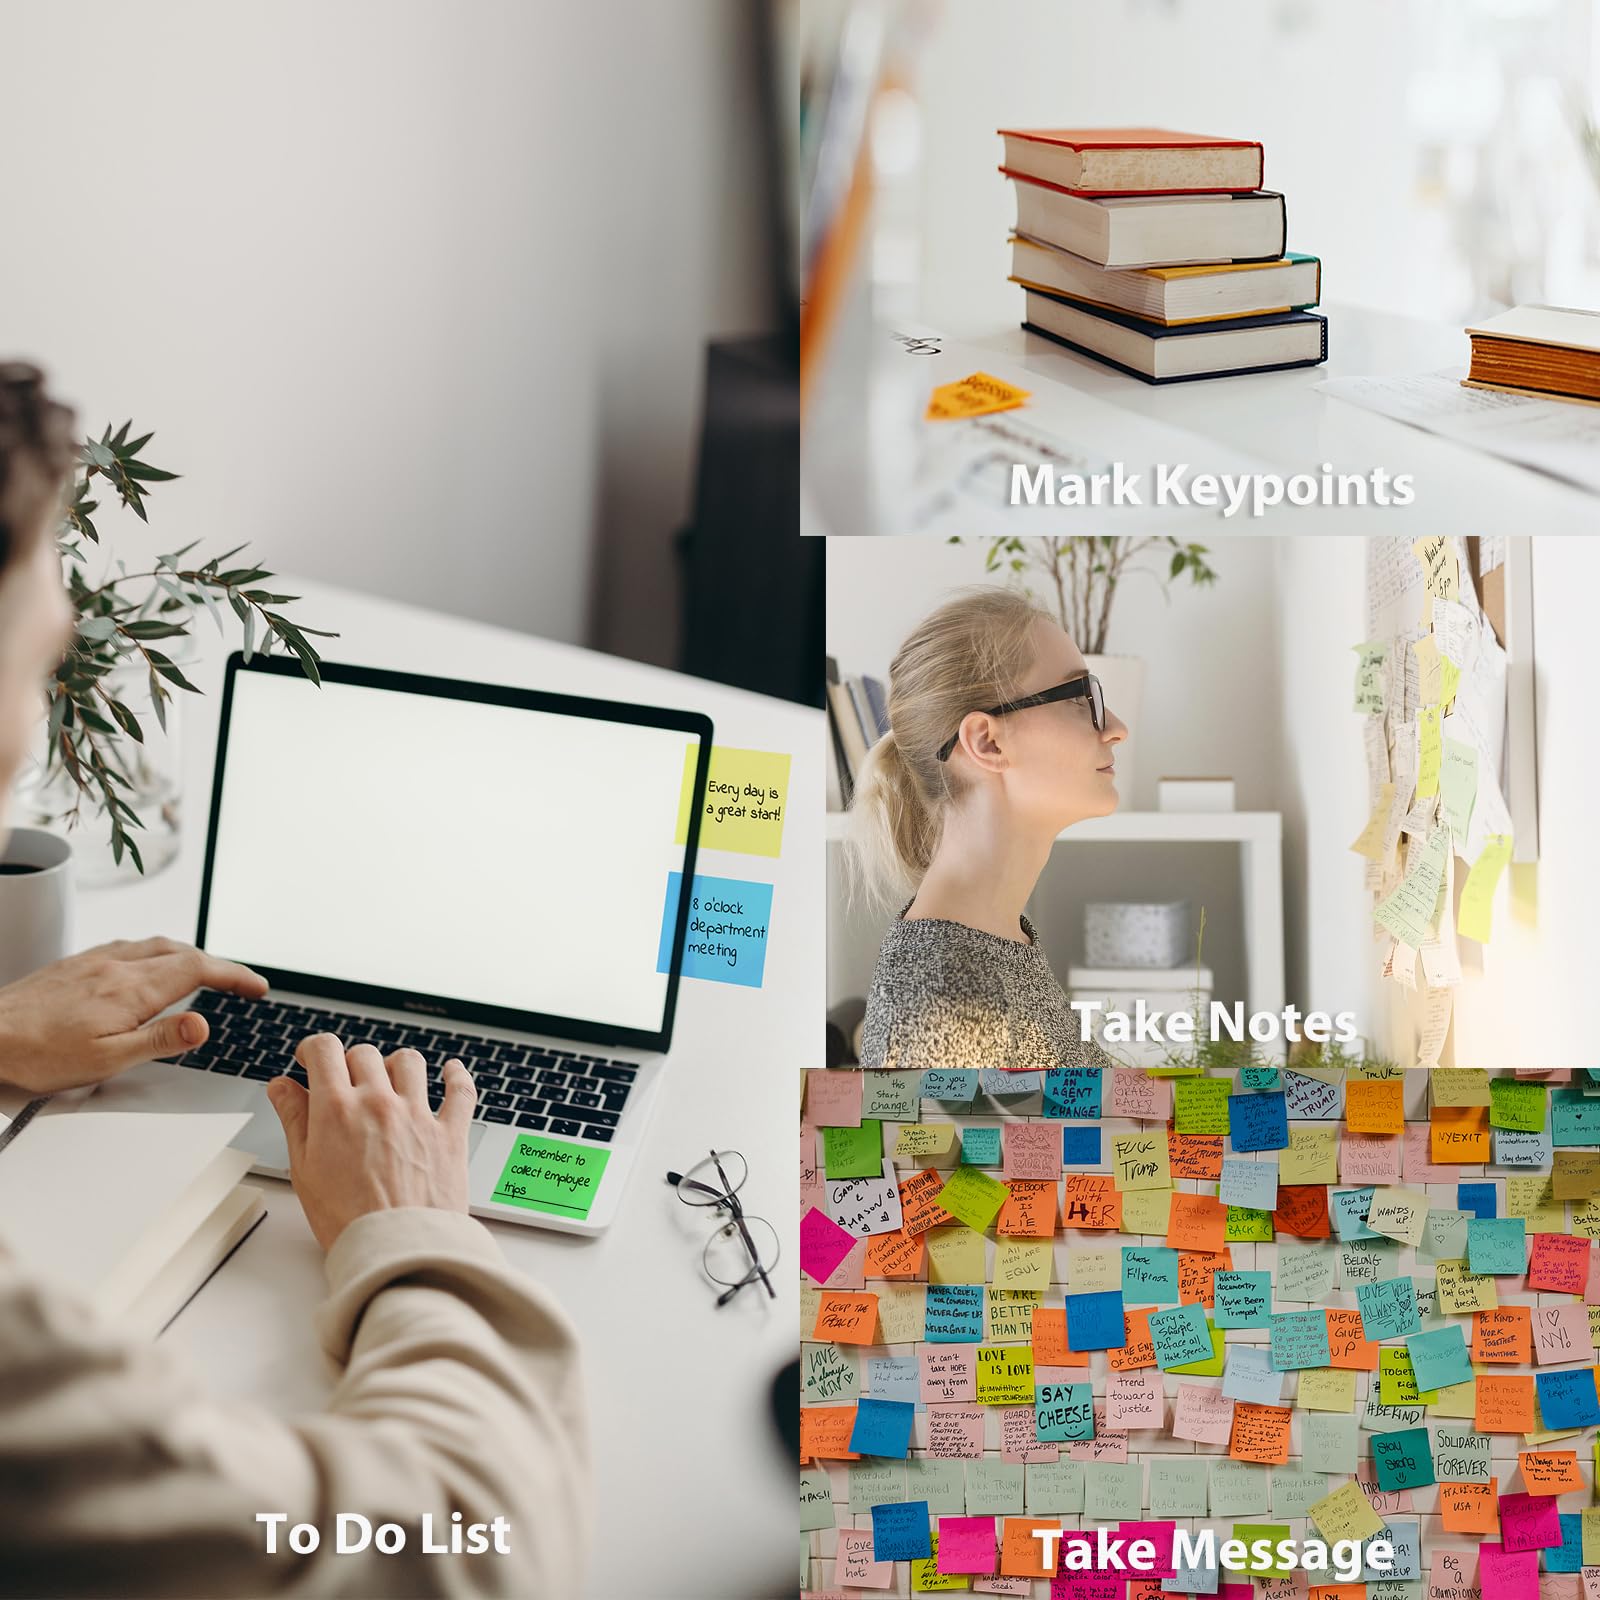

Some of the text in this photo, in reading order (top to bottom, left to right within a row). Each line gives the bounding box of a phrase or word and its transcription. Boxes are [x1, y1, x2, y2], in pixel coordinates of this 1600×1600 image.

[708, 781, 779, 805] Every day is
[706, 804, 781, 823] a great start!
[693, 898, 744, 915] 8 o'clock
[690, 918, 765, 939] department
[688, 943, 737, 966] meeting
[1064, 1069, 1100, 1077] CAN BE
[929, 1073, 965, 1086] Do you
[1053, 1088, 1092, 1098] AGENT
[1289, 1094, 1309, 1110] voted
[1300, 1090, 1335, 1116] TRUMP
[1050, 1106, 1098, 1117] CHANGE
[1438, 1132, 1482, 1143] NYEXIT
[520, 1144, 585, 1166] Remember to
[1116, 1141, 1155, 1158] FUCK
[511, 1165, 590, 1192] collect employee
[1067, 1177, 1109, 1192] STILL
[504, 1183, 526, 1198] trips
[1378, 1207, 1409, 1217] WANDS
[868, 1236, 892, 1259] FIGHT
[1349, 1241, 1367, 1251] YOU
[1002, 1256, 1020, 1265] MEN
[1343, 1254, 1381, 1266] BELONG
[927, 1286, 952, 1295] NEVER
[989, 1290, 1037, 1301] WE ARE
[1358, 1283, 1391, 1302] LOVE
[926, 1307, 952, 1316] NEVER
[1479, 1312, 1492, 1323] BE
[925, 1324, 966, 1334] NEVER GIVE
[992, 1324, 1017, 1336] THAN
[1335, 1328, 1362, 1339] GIVE
[978, 1350, 1006, 1362] LOVE
[1118, 1345, 1135, 1356] THE
[810, 1347, 838, 1373] LOVE
[1111, 1359, 1124, 1368] OF
[931, 1364, 967, 1373] take HOPE
[1008, 1364, 1031, 1376] LOVE
[949, 1378, 968, 1386] from
[1117, 1378, 1145, 1387] trend
[817, 1379, 842, 1398] WIN
[1042, 1385, 1073, 1403] SAY
[1110, 1390, 1155, 1400] toward
[1003, 1411, 1030, 1420] GUARD
[1038, 1404, 1091, 1429] CHEESE
[1437, 1430, 1491, 1450] SOLIDARITY
[1437, 1453, 1489, 1477] FOREVER
[1453, 1502, 1471, 1511] USA
[846, 1537, 874, 1551] Love
[1443, 1555, 1459, 1570] Be
[1260, 1577, 1293, 1588] BE AN
[1454, 1572, 1463, 1583] a
